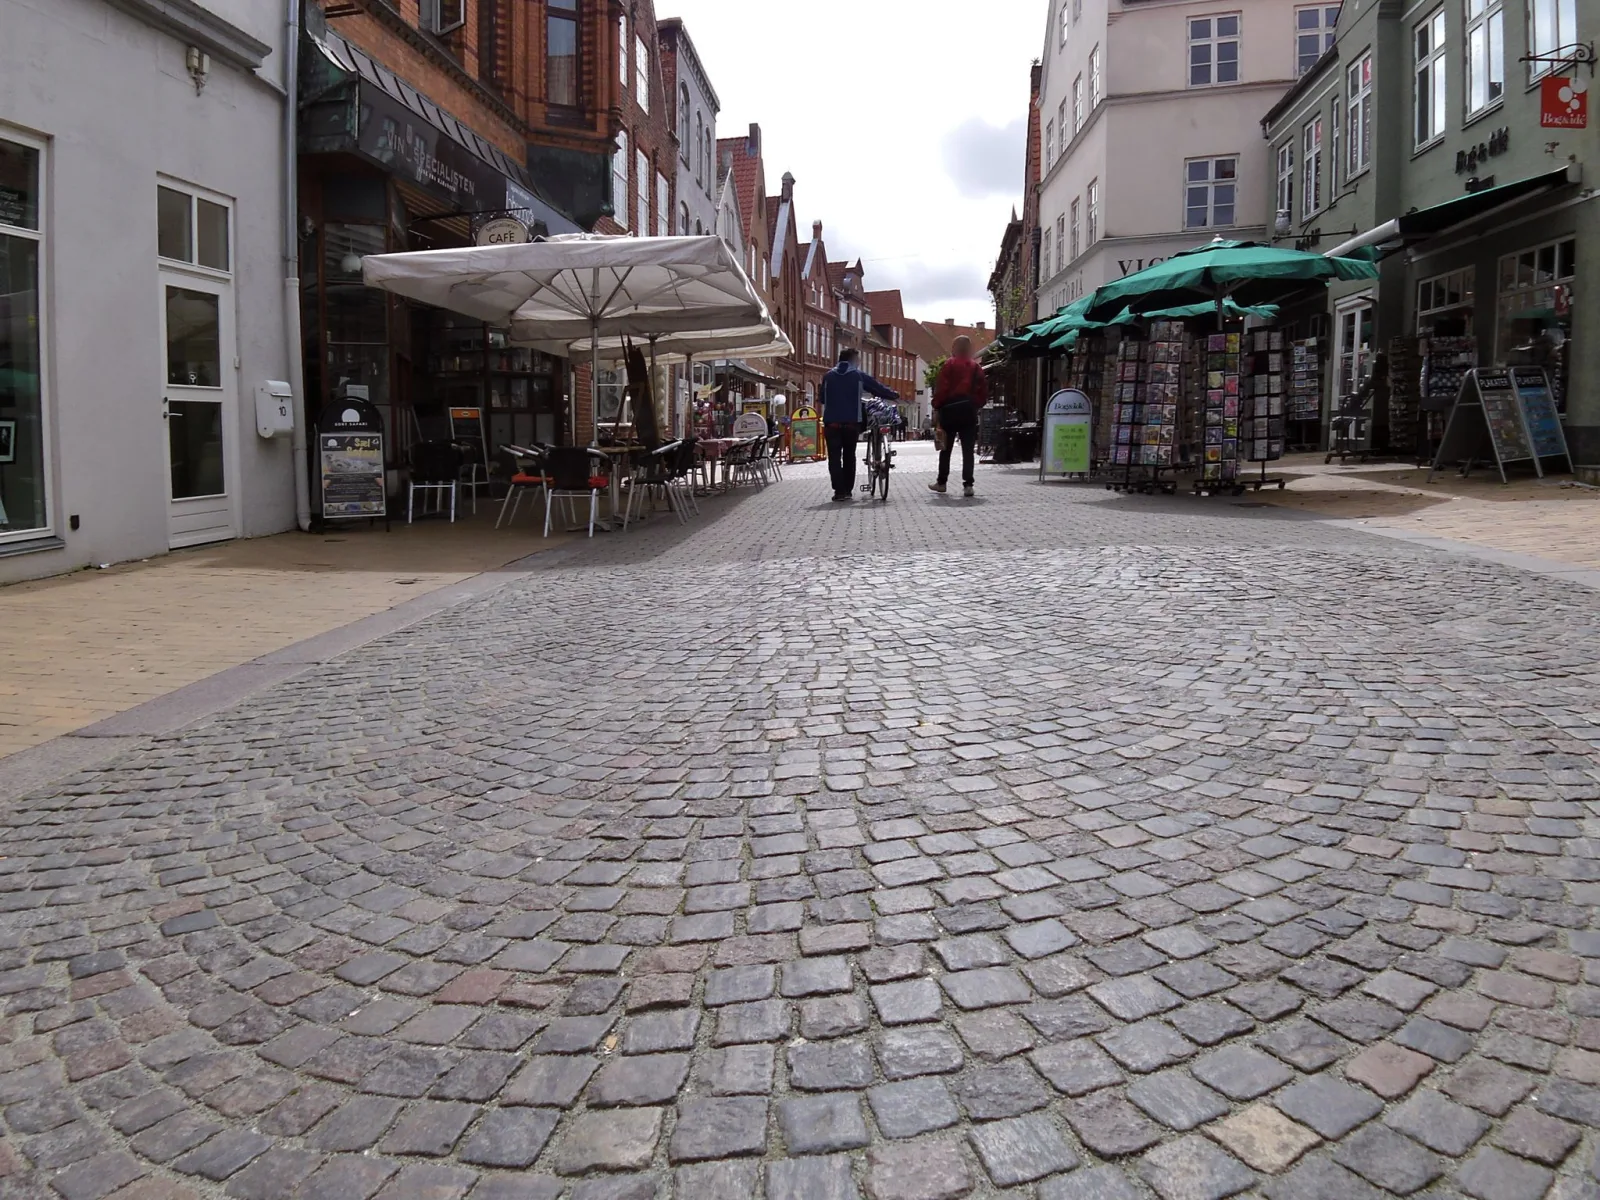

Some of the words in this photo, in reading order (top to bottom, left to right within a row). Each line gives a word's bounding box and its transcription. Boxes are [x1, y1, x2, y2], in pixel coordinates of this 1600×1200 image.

[387, 129, 405, 154] VIN
[413, 147, 475, 196] SPECIALISTEN
[488, 230, 515, 244] CAFÉ
[1479, 377, 1508, 388] PLAKATER
[278, 406, 287, 417] 10
